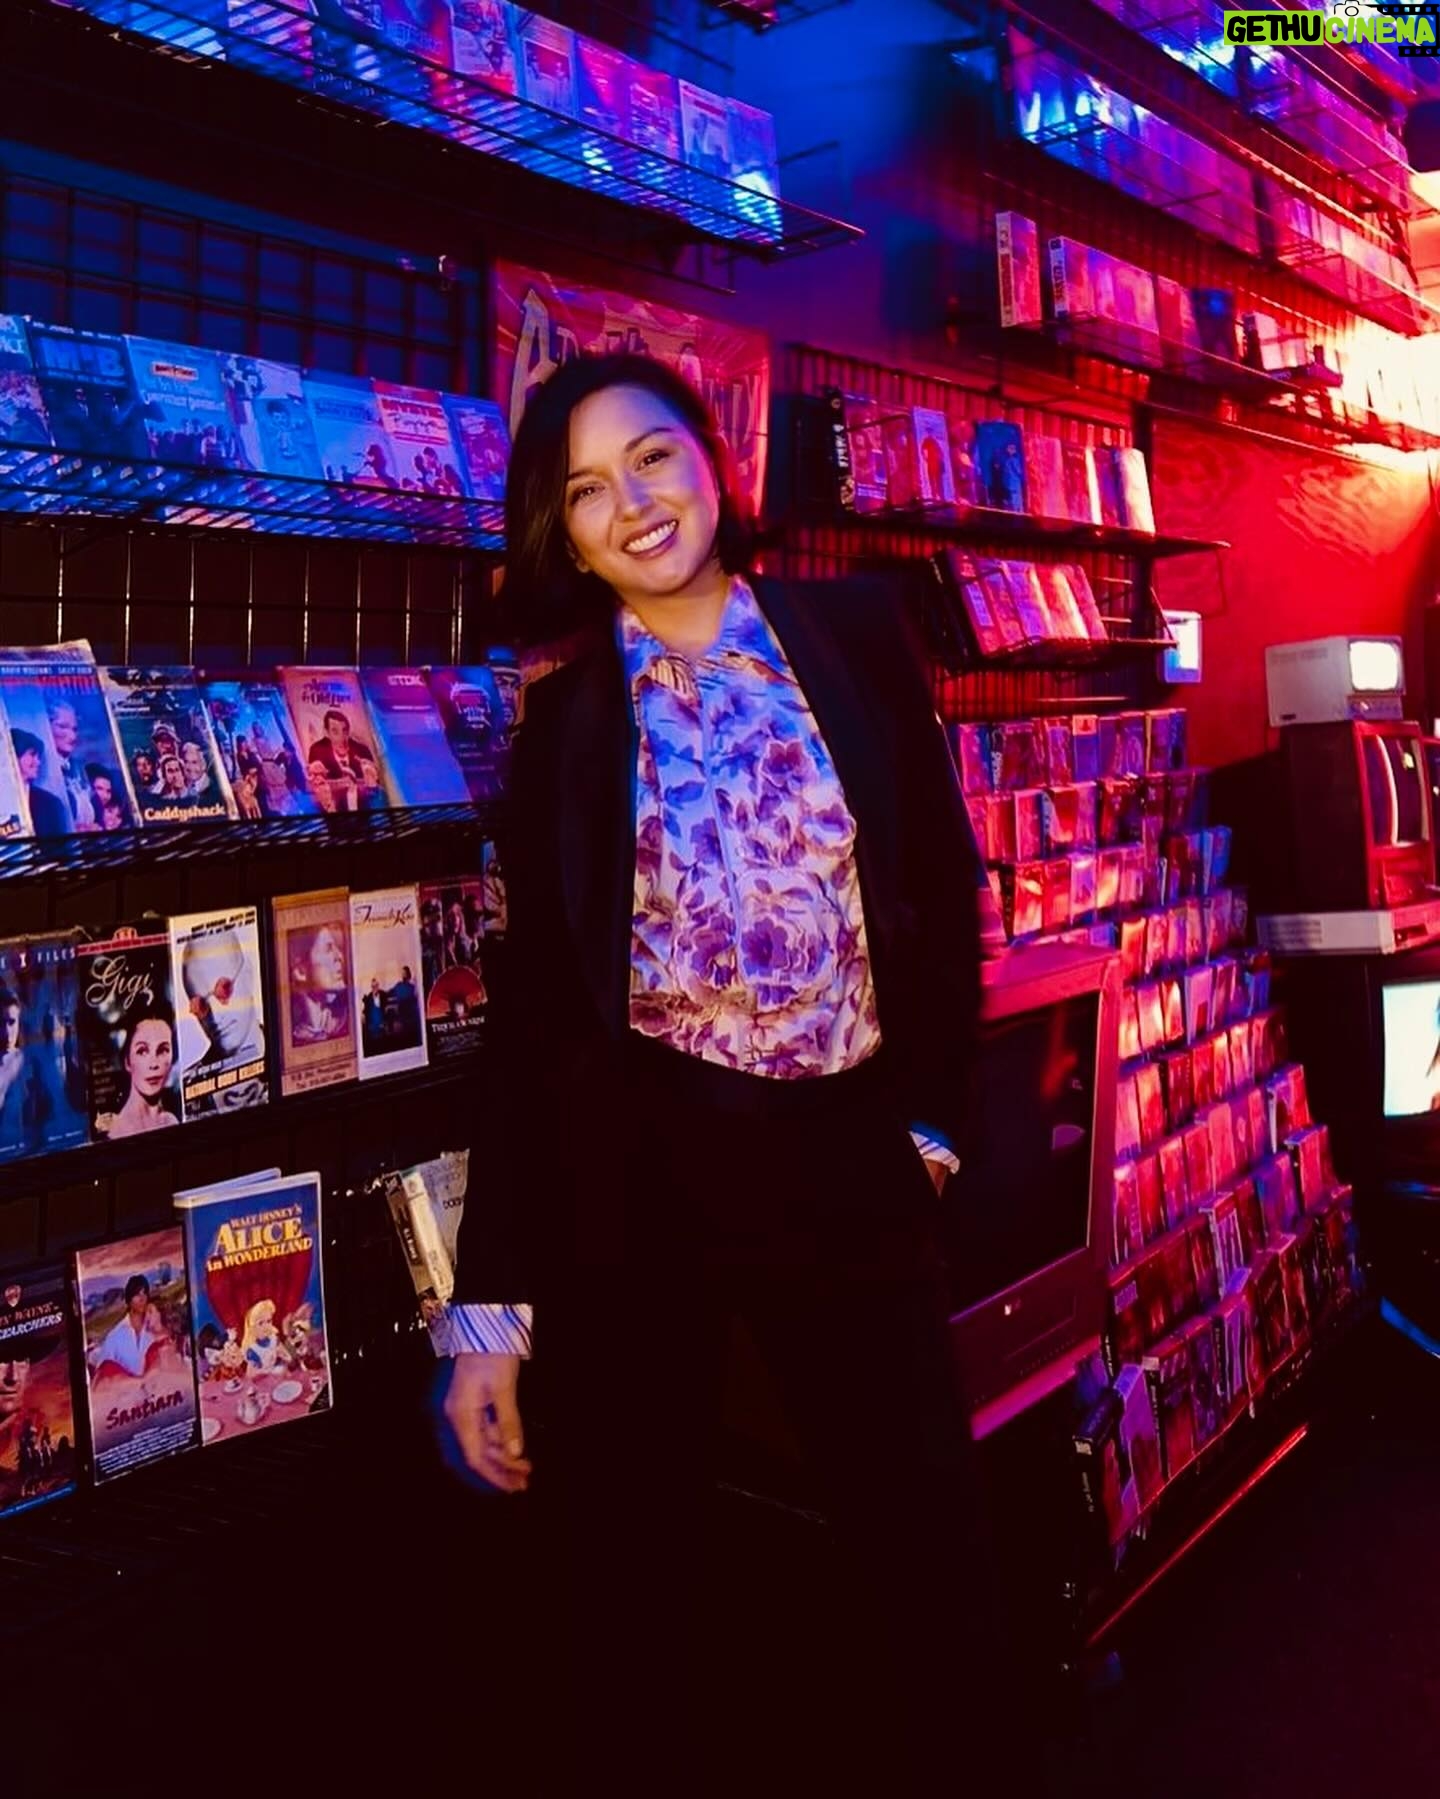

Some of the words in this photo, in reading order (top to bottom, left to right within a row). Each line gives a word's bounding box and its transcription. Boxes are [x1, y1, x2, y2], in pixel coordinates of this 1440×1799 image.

[144, 804, 226, 821] Caddyshack
[37, 947, 76, 964] FILES
[85, 954, 155, 1010] Gigi
[230, 1215, 258, 1229] WALT
[214, 1217, 303, 1257] ALICE
[223, 1237, 313, 1268] WONDERLAND
